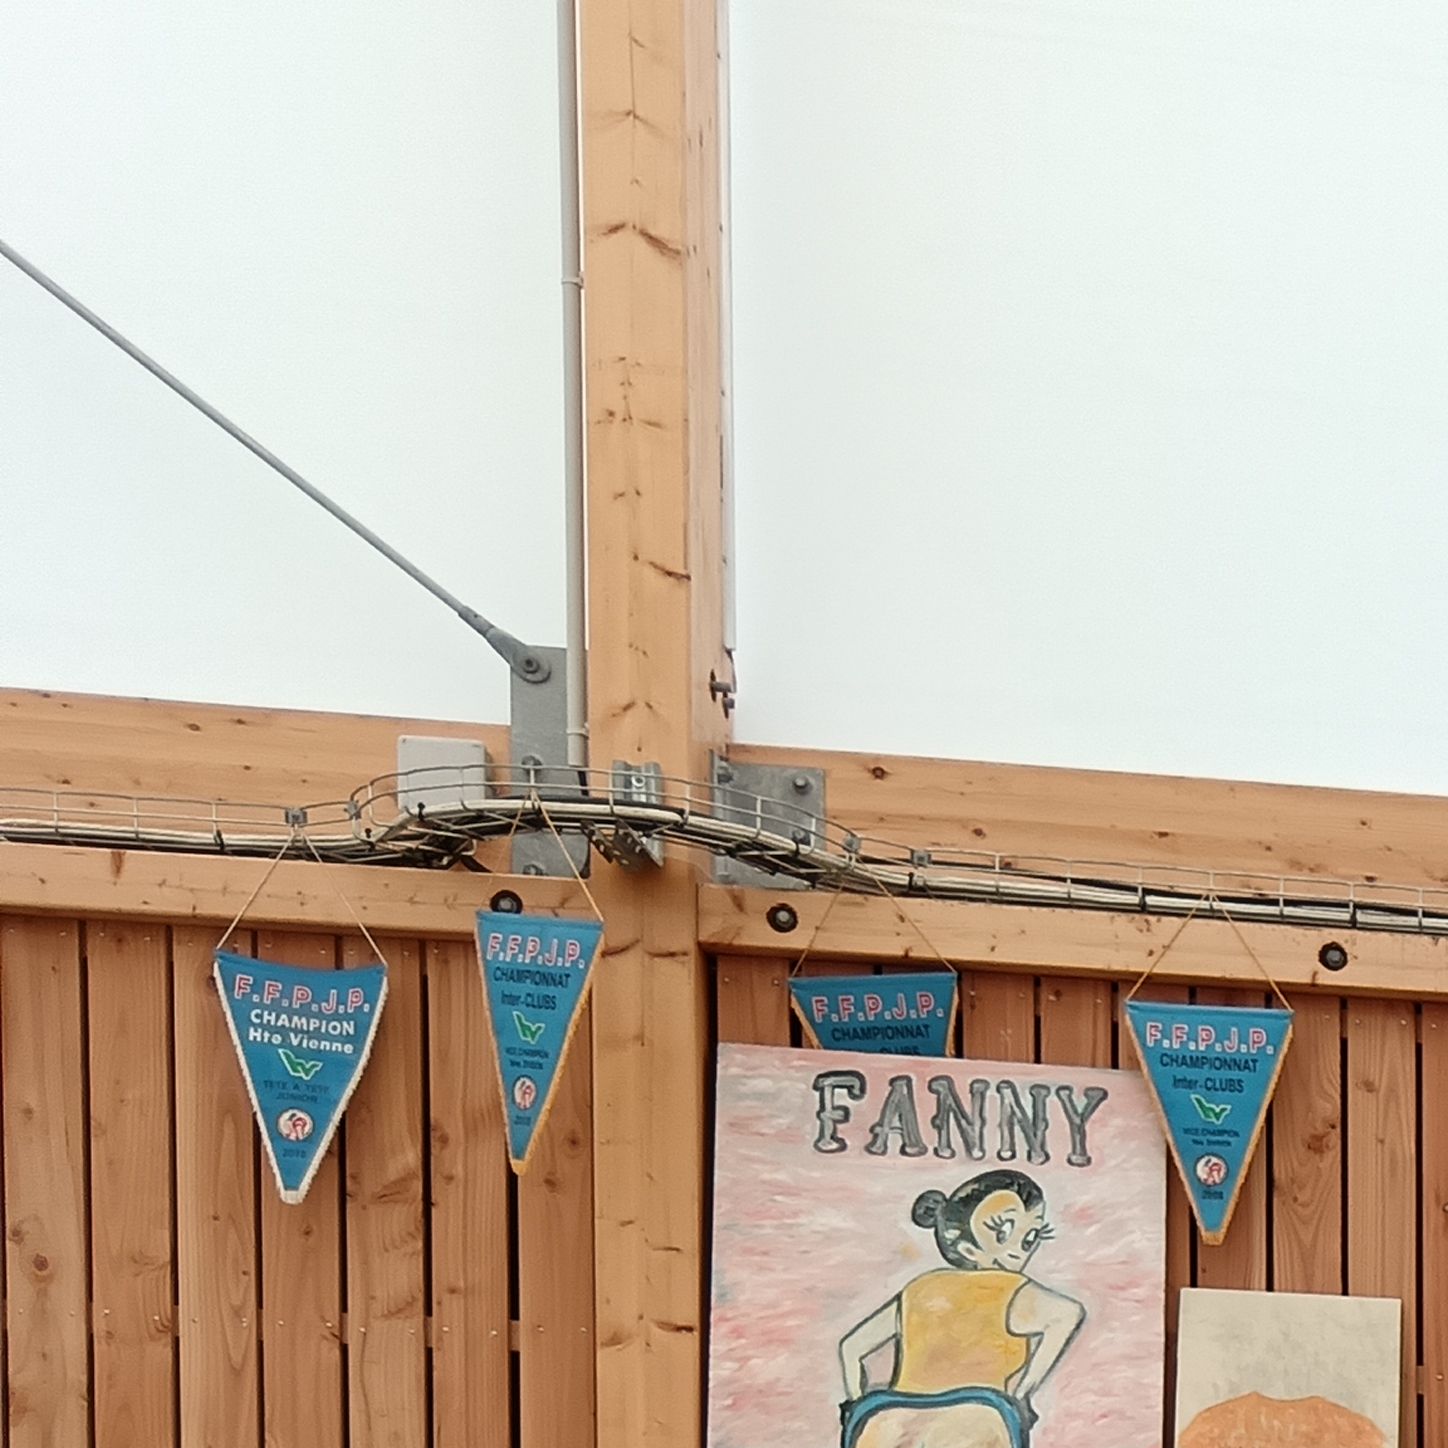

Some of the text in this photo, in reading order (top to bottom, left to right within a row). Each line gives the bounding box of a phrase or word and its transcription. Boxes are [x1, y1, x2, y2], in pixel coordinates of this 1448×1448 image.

[486, 932, 585, 968] F.F.P.J.P.
[493, 966, 571, 988] CHAMPIONNAT
[235, 974, 370, 1014] F.F.P.J.P.
[812, 991, 944, 1023] F.F.P.J.P.
[250, 1009, 355, 1036] CHAMPION
[831, 1024, 930, 1042] CHAMPIONNAT
[248, 1027, 354, 1054] Hte Vienne
[1145, 1021, 1275, 1055] F.F.P.J.P.
[1160, 1052, 1258, 1073] CHAMPIONNAT
[813, 1070, 1108, 1167] FANNY
